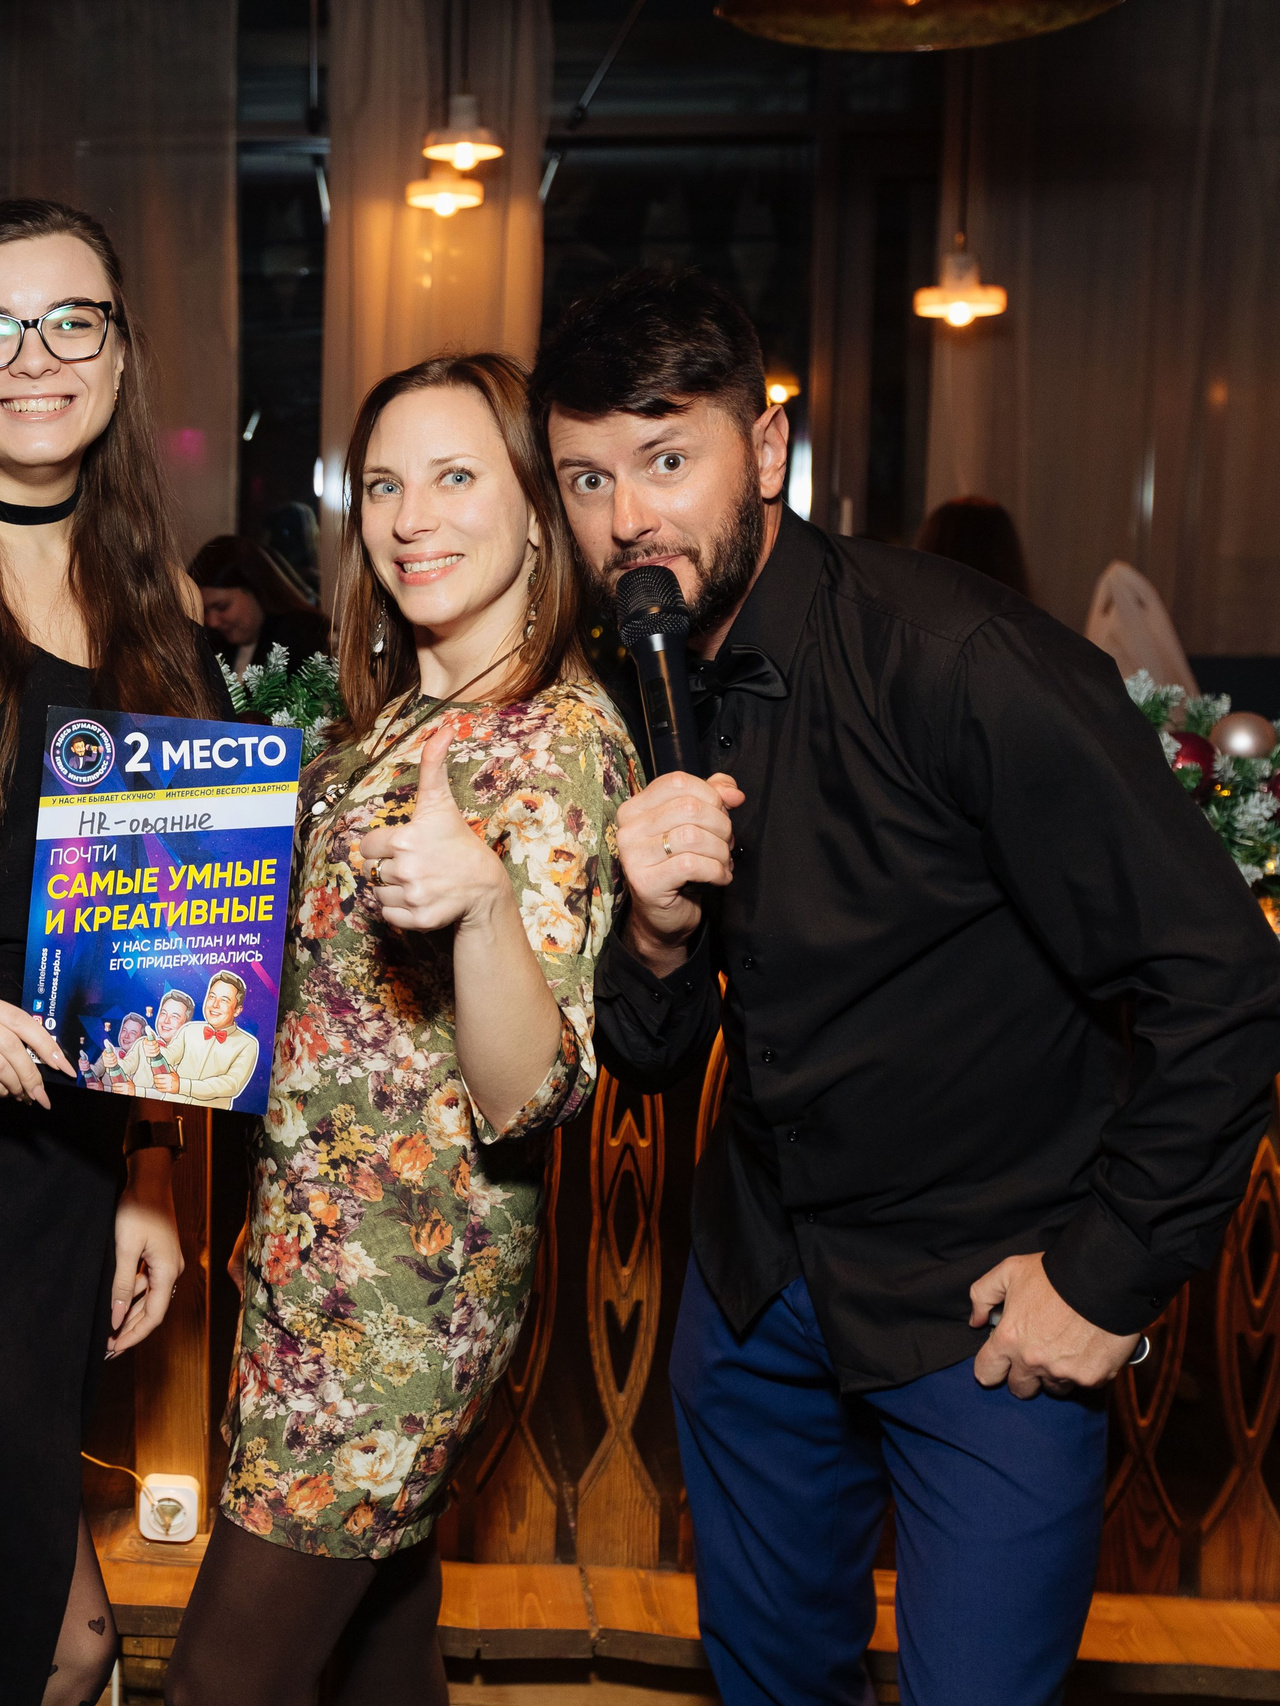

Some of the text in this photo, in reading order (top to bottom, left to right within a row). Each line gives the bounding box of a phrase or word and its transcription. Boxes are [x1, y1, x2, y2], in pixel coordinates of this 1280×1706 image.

[55, 723, 112, 753] ЗДЕСЬ ДУМАЮТ ЛЮДИ
[124, 732, 287, 772] 2 МЕСТО
[67, 760, 109, 782] ИНТЕЛКРОСС
[88, 794, 119, 803] БЫВАЕТ
[120, 792, 156, 801] СКУЧНО!
[165, 789, 215, 798] ИНТЕРЕСНО!
[216, 787, 250, 795] ВЕСЕЛО!
[251, 784, 290, 793] АЗАРТНО!
[50, 844, 117, 866] ПОЧТИ
[47, 858, 277, 900] САМЫЕ УМНЫЕ
[44, 894, 275, 935] И КРЕАТИВНЫЕ
[112, 932, 261, 954] У НАС БЫЛ ПЛАН И МЫ
[37, 947, 48, 995] @intelcross
[109, 950, 264, 971] ЕГО ПРИДЕРЖИВАЛИСЬ
[47, 949, 62, 1017] intelcross.spb.ru
